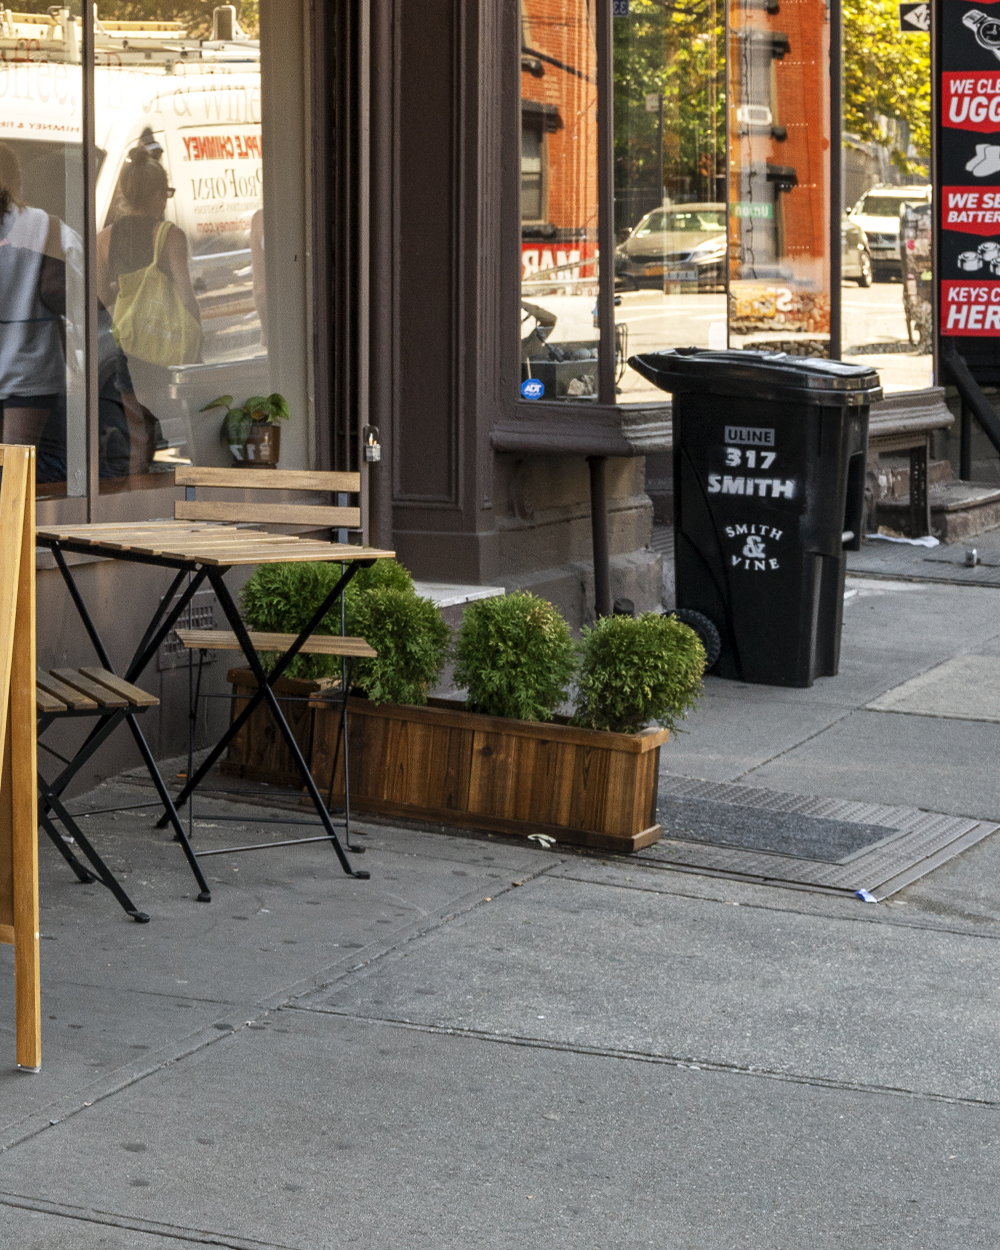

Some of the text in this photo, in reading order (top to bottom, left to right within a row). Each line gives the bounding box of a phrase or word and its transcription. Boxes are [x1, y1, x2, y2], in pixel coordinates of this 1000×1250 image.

[950, 79, 975, 94] WE
[948, 193, 979, 208] WE
[948, 287, 989, 301] KEYS
[947, 305, 1000, 329] HER
[524, 384, 542, 393] ADT
[727, 428, 772, 444] ULINE
[725, 447, 776, 469] 317
[707, 474, 796, 499] SMITH
[725, 523, 783, 541] SMITH
[743, 535, 766, 559] &
[731, 555, 780, 571] VINE
